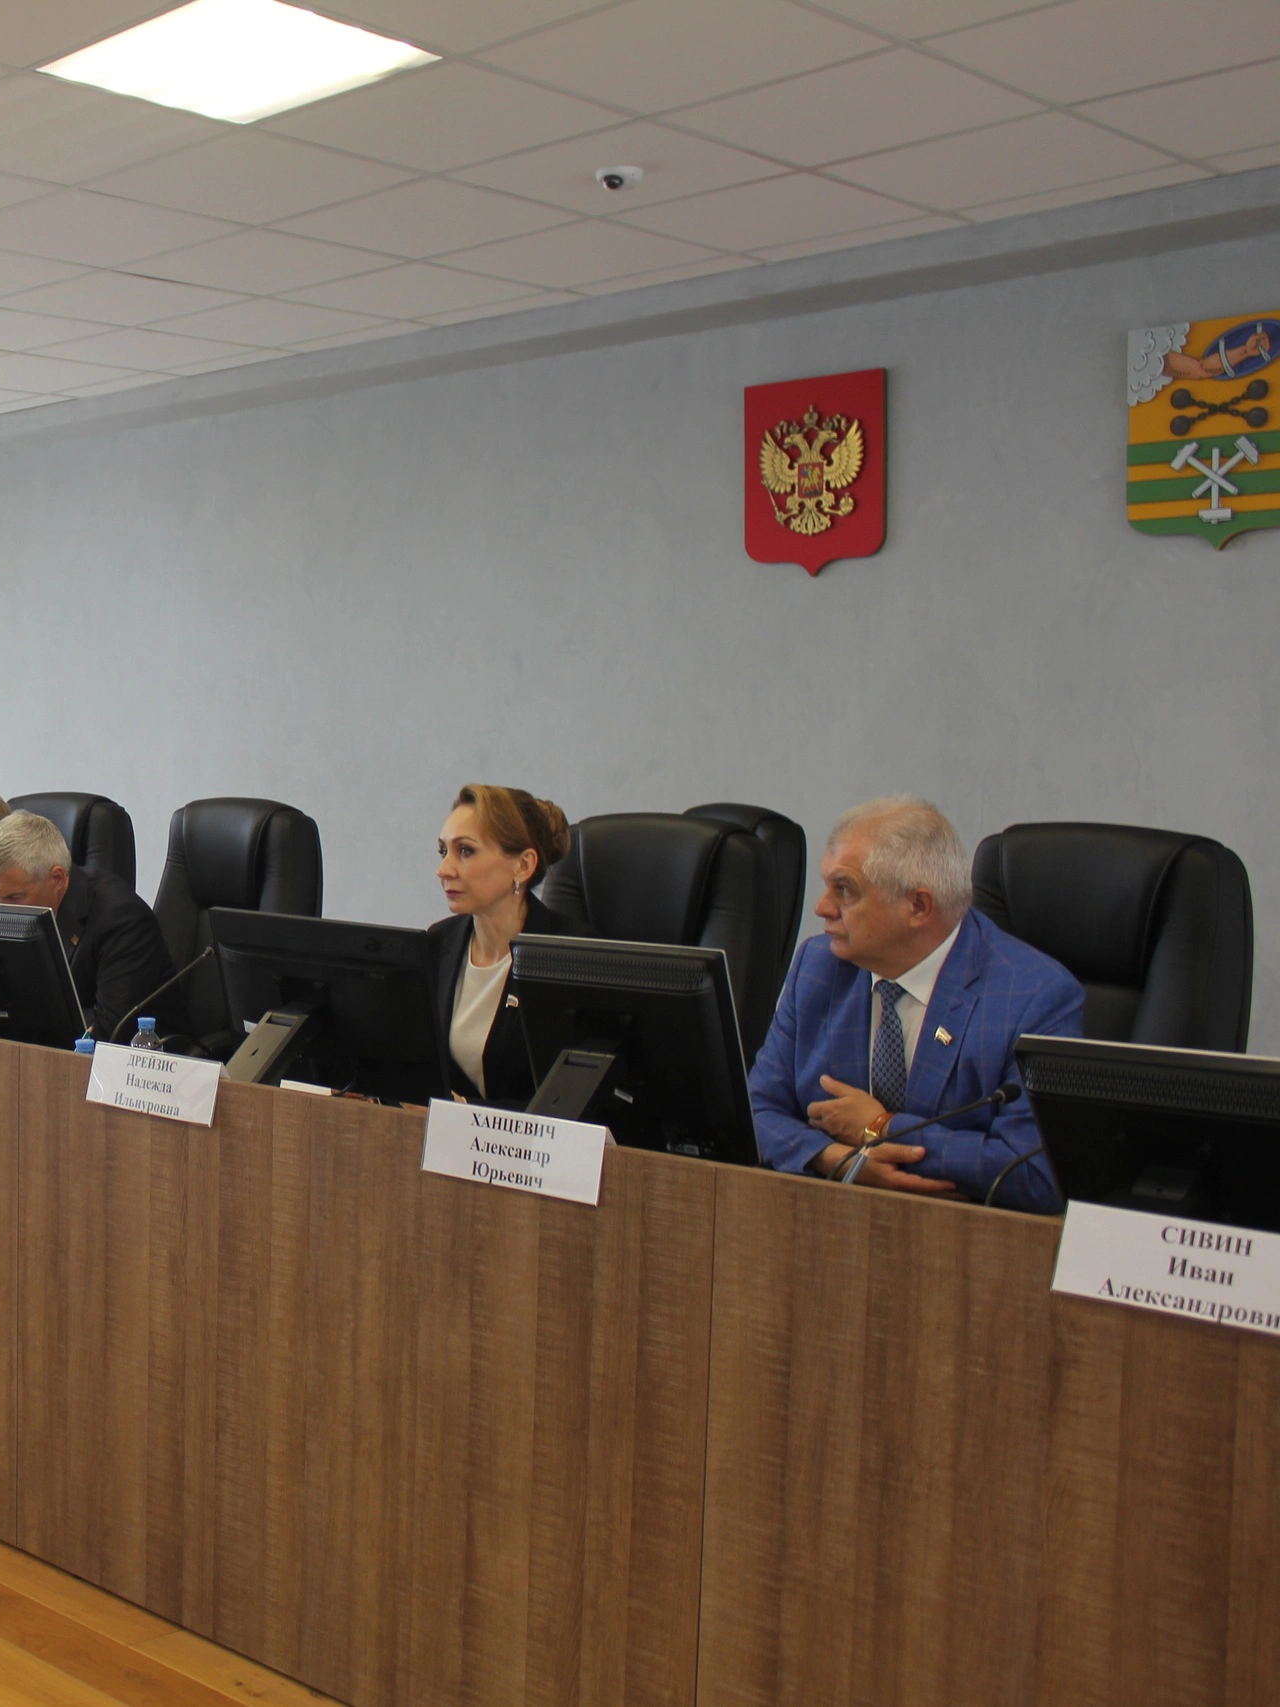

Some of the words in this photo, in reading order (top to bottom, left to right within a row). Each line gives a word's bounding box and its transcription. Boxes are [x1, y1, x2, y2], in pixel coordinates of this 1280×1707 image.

[127, 1054, 178, 1073] ДРЕЙЗИС
[126, 1073, 172, 1093] Надежда
[114, 1091, 180, 1117] Ильнуровна
[470, 1112, 556, 1140] ХАНЦЕВИЧ
[470, 1136, 551, 1168] Александр
[471, 1160, 544, 1189] Юрьевич
[1160, 1224, 1253, 1257] СИВИН
[1167, 1255, 1235, 1287] Иван
